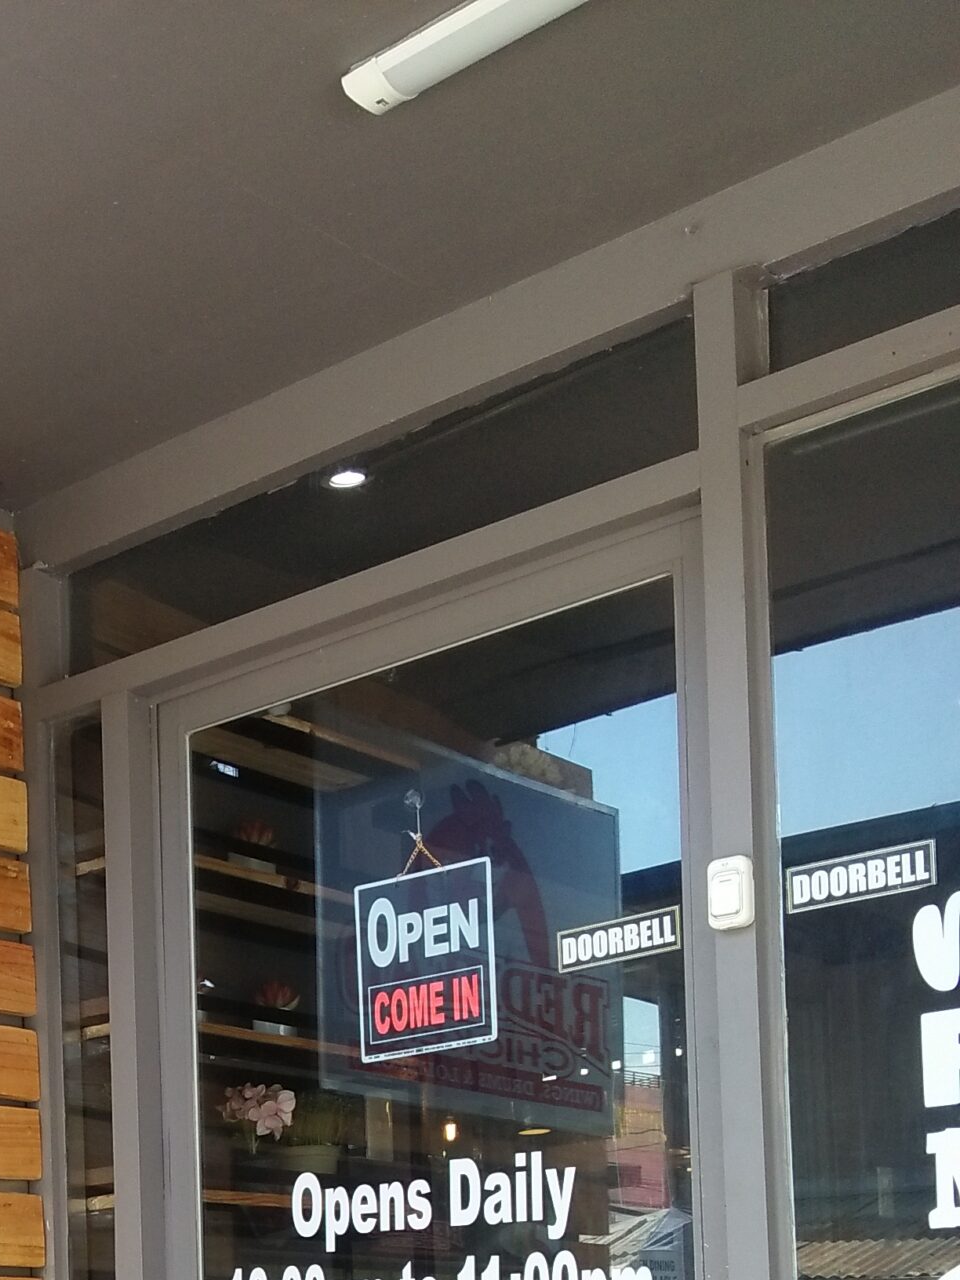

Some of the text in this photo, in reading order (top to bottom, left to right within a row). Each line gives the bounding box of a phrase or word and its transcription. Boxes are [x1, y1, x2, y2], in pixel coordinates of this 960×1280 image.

[793, 850, 930, 905] DOORBELL
[367, 898, 479, 967] OPEN
[562, 914, 675, 965] DOORBELL
[374, 974, 480, 1035] COME IN
[292, 1151, 576, 1253] Opens Daily
